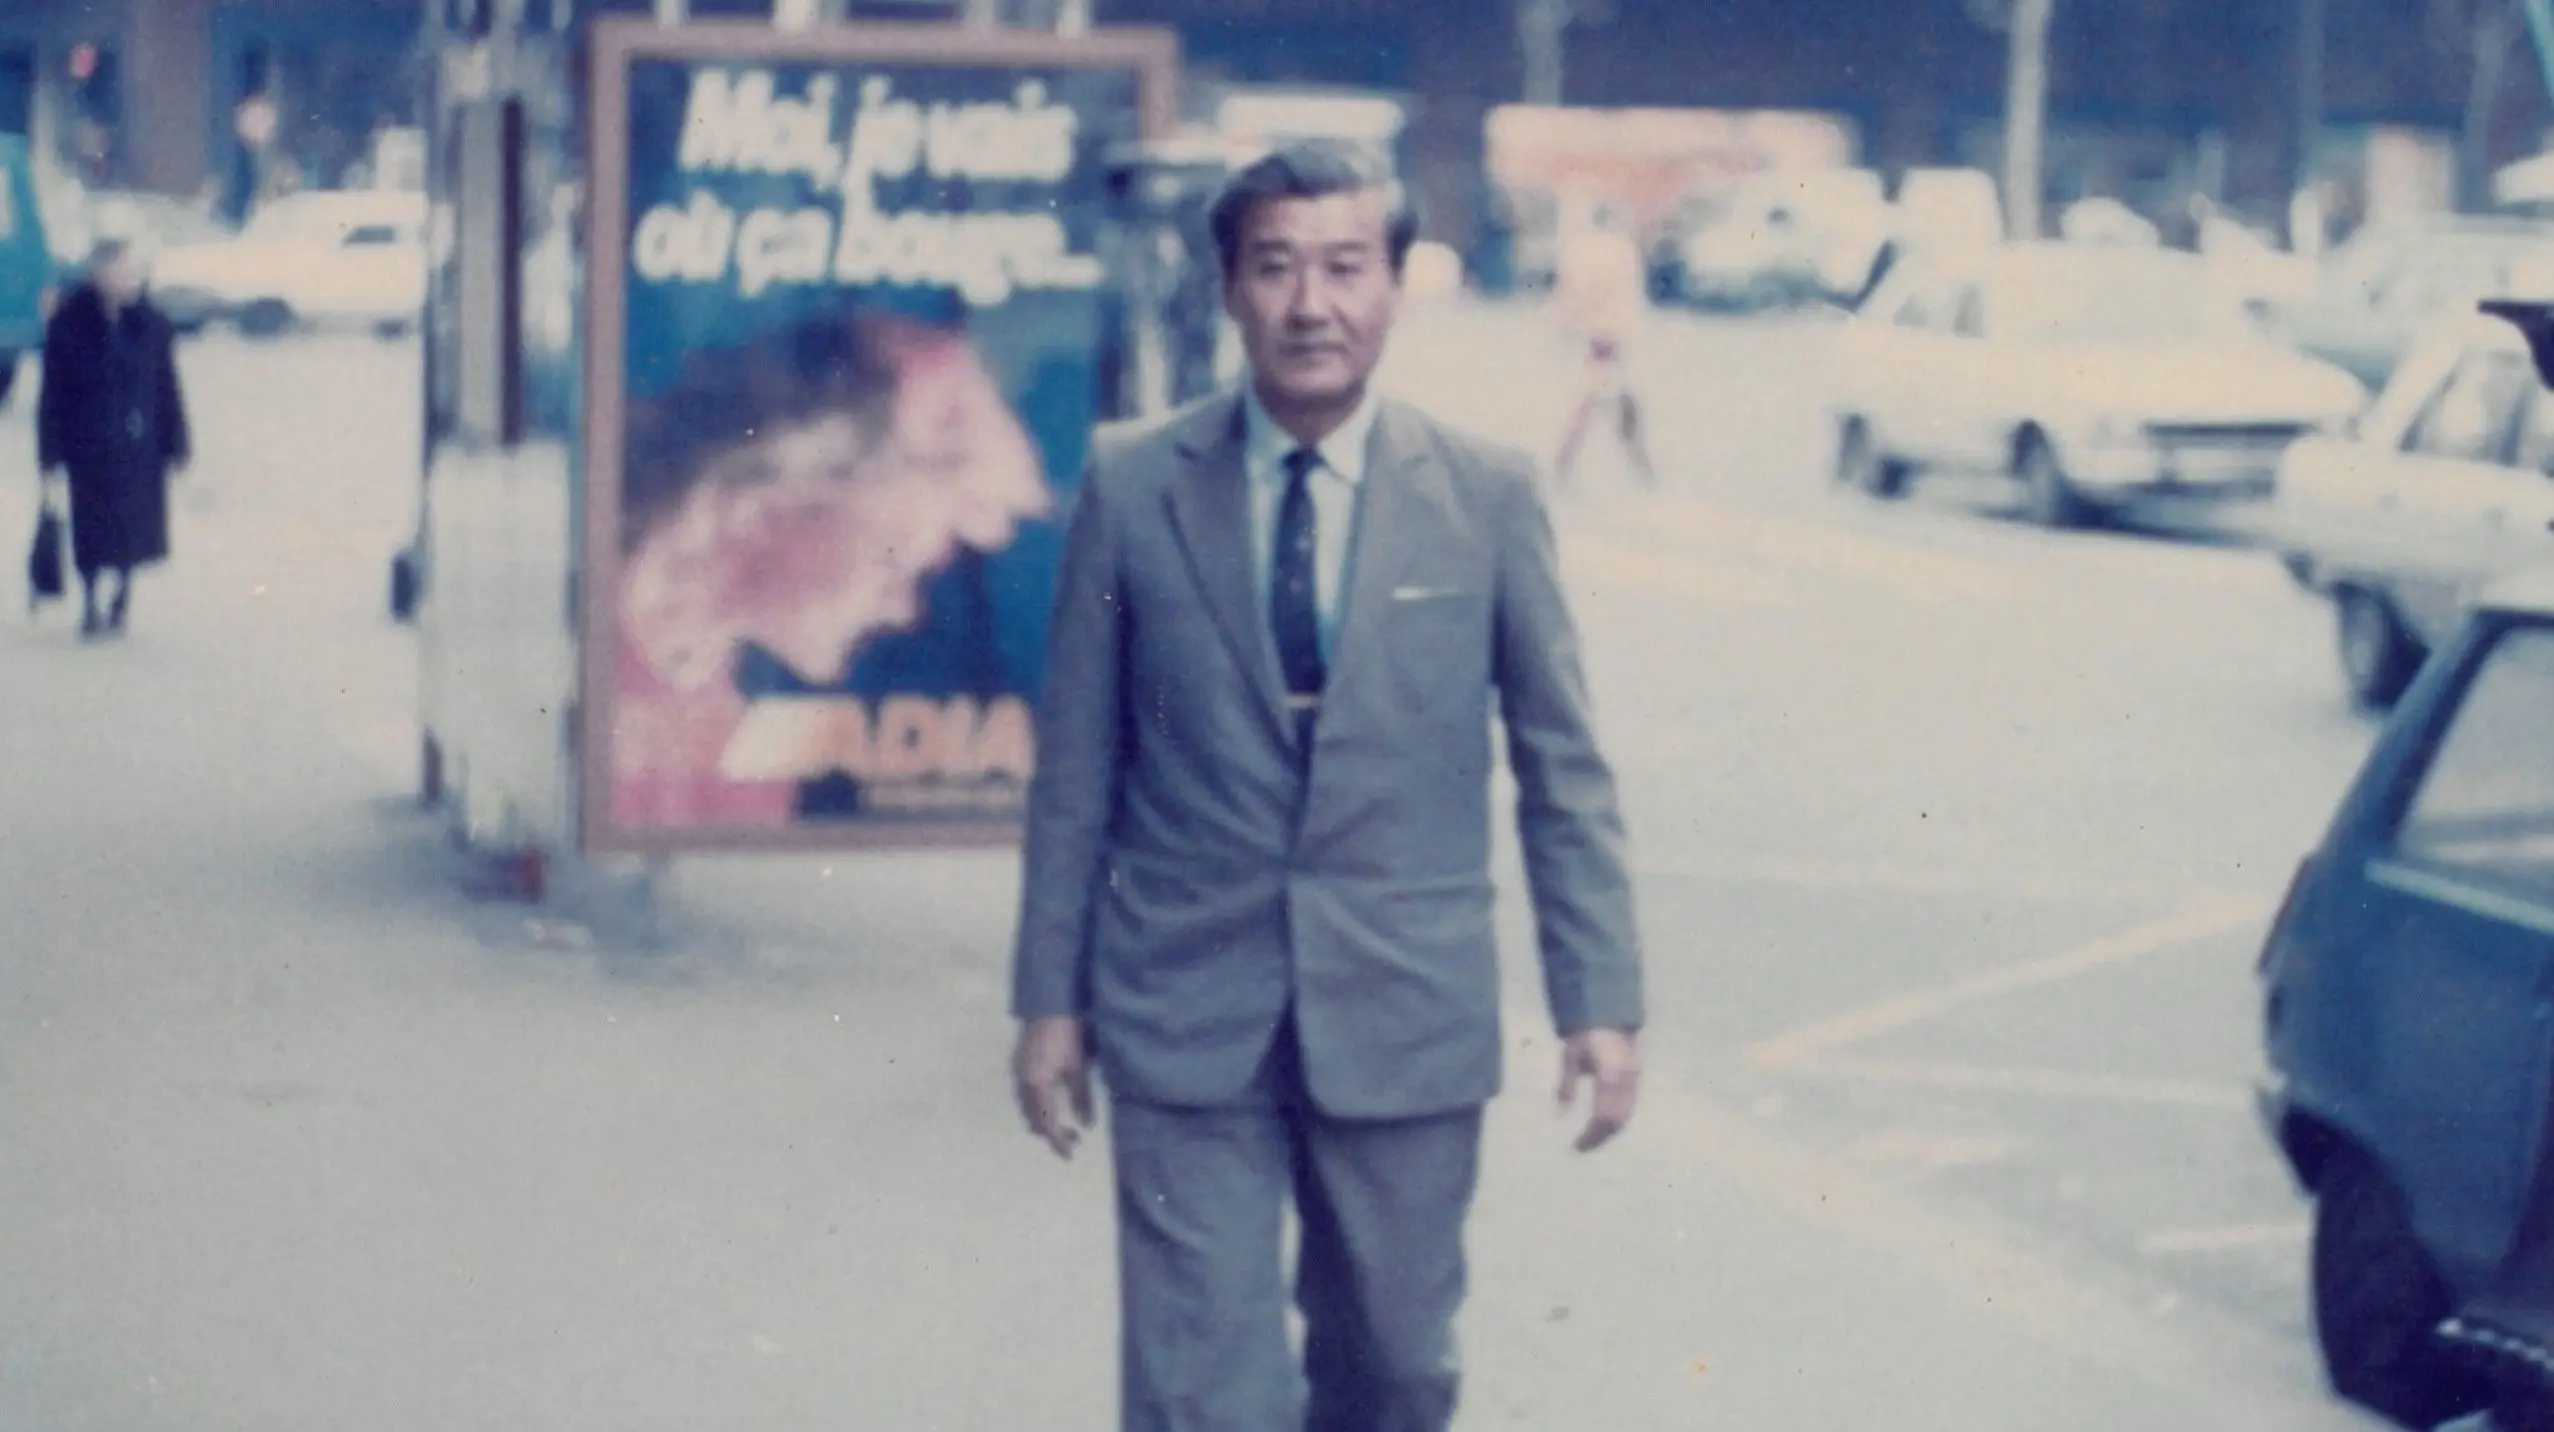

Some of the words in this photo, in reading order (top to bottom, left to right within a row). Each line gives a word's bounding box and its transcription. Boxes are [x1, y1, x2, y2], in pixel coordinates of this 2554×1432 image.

[680, 68, 842, 191] Moi,
[841, 76, 923, 193] je
[928, 79, 1079, 180] vais
[635, 189, 734, 281] où
[736, 207, 831, 297] ça
